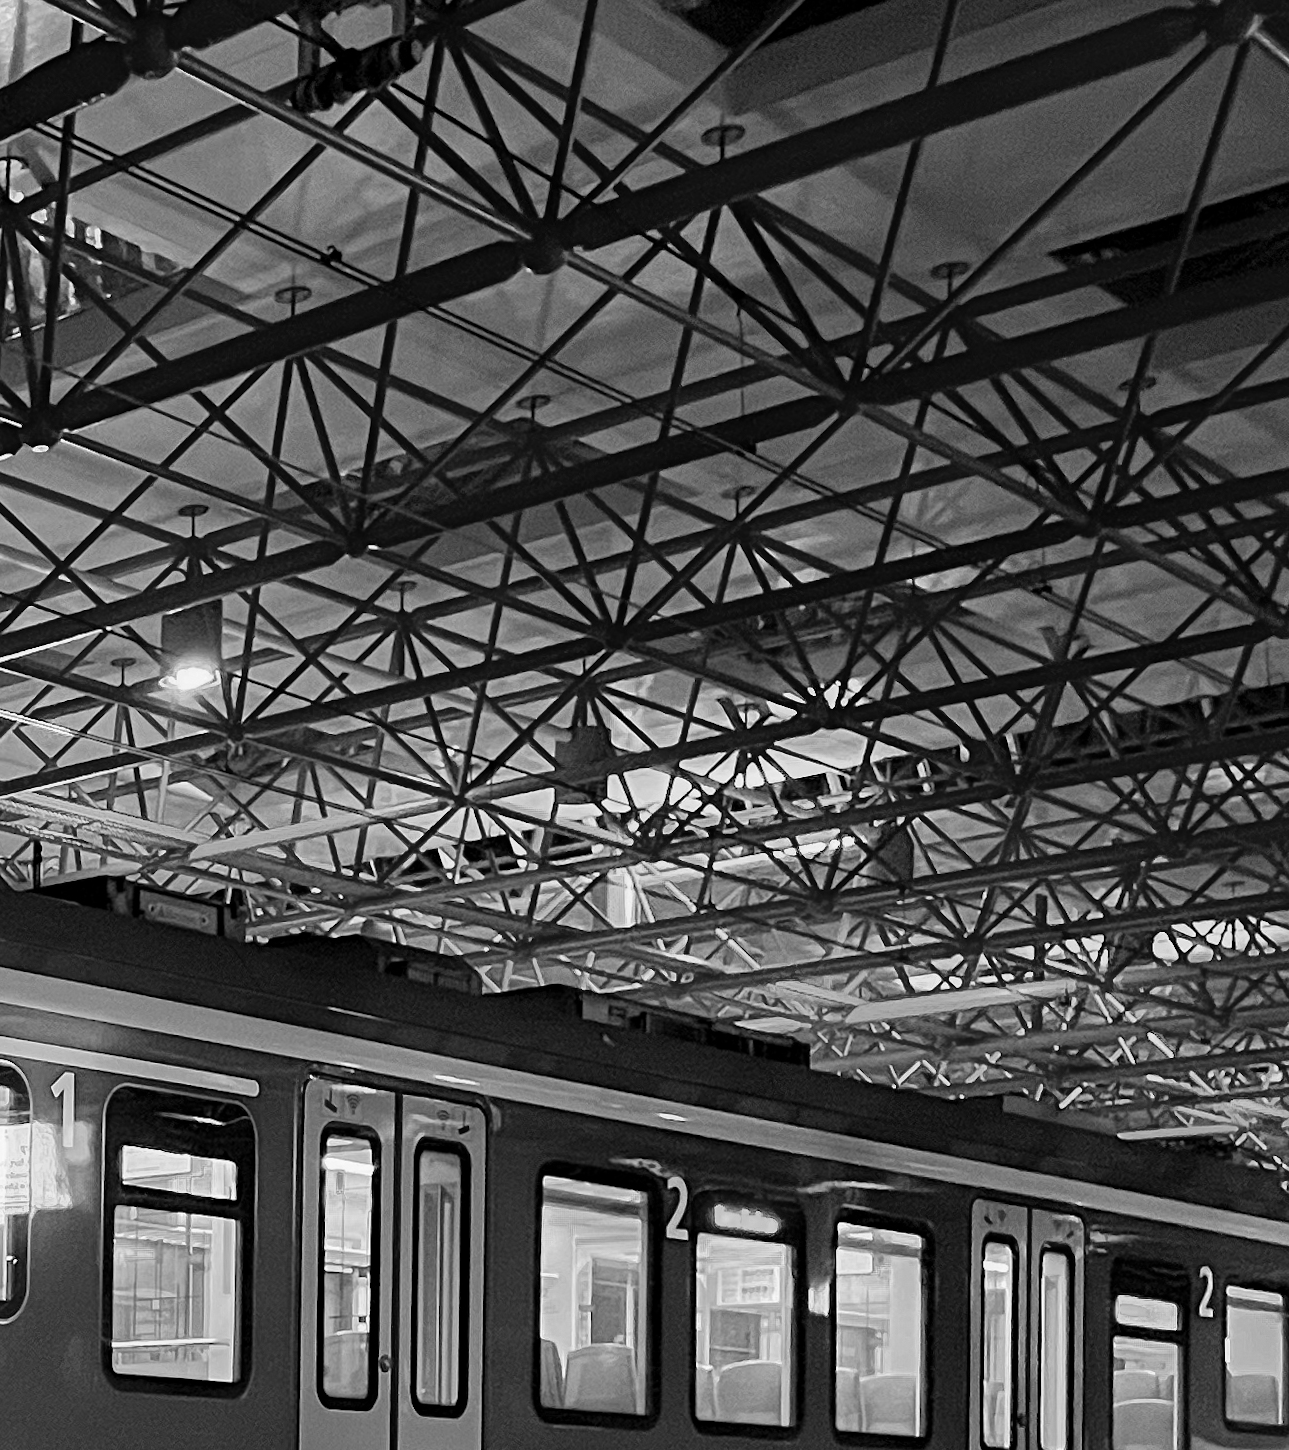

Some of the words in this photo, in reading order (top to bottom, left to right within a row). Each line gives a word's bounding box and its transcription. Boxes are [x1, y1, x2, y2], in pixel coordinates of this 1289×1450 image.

[50, 1071, 75, 1147] 1
[666, 1176, 689, 1241] 2
[1199, 1265, 1214, 1317] 2
